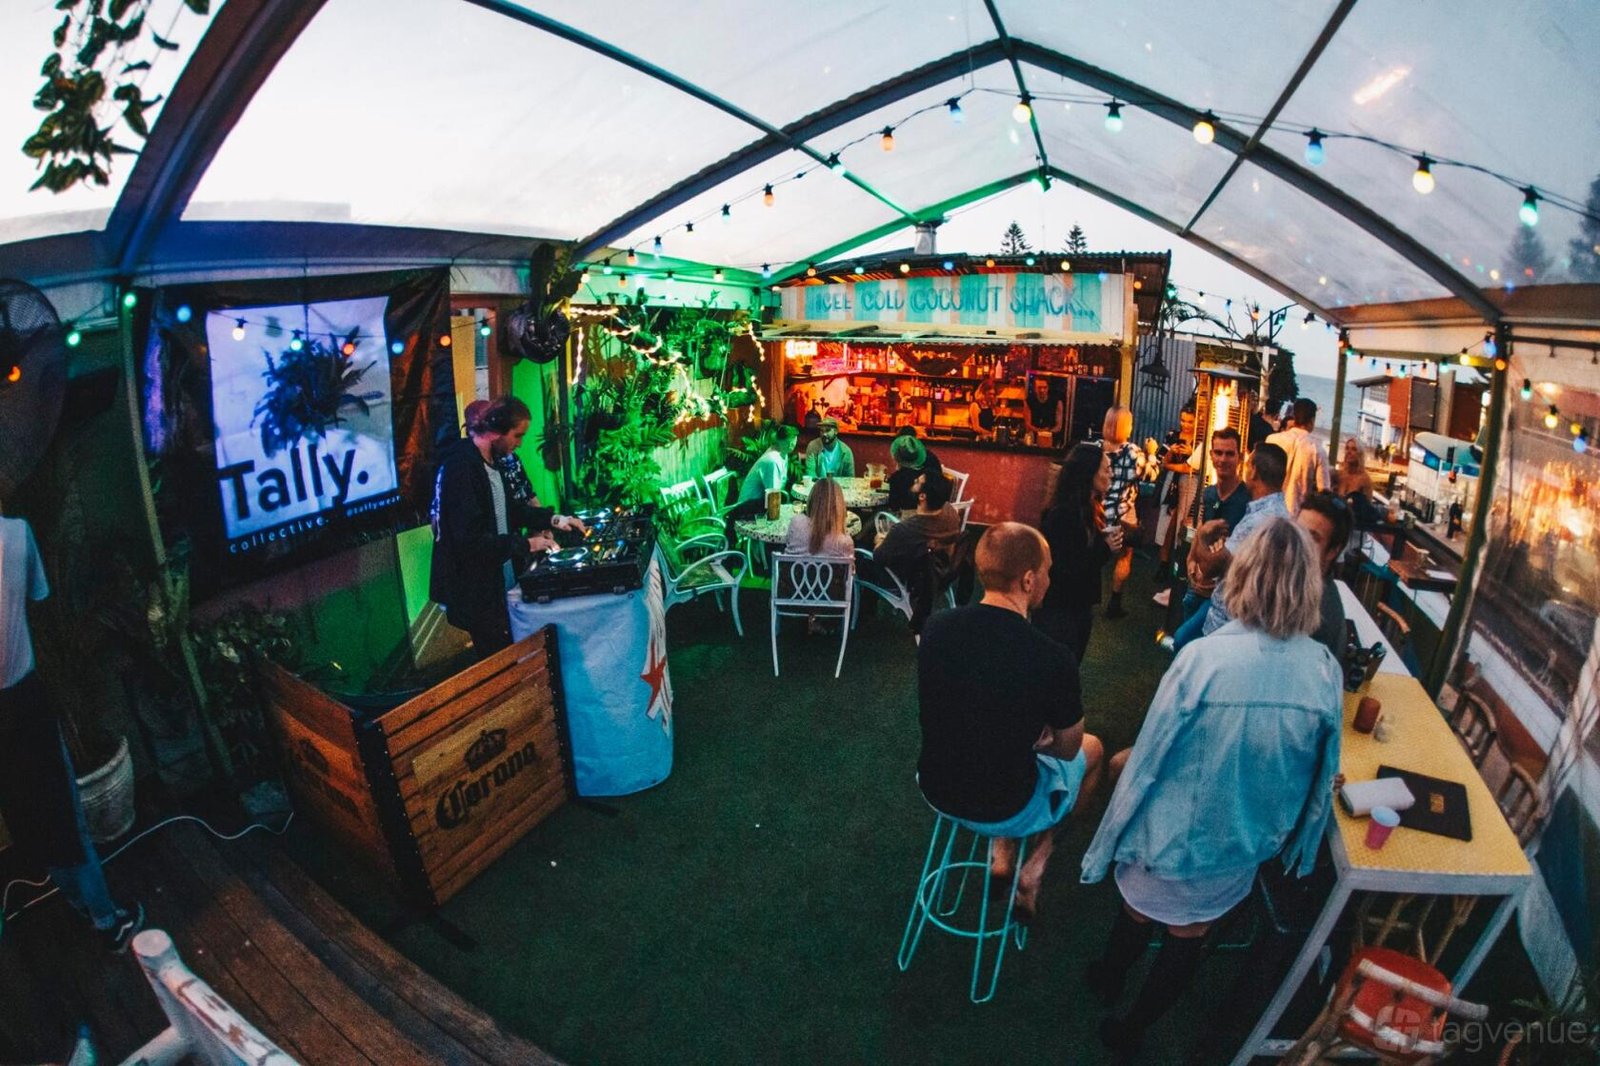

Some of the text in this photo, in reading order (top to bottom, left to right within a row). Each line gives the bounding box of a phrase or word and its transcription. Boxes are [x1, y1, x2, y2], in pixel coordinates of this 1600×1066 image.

[860, 288, 905, 312] COLD
[909, 286, 1003, 314] COCONUT
[216, 444, 370, 522] Tally.
[436, 741, 538, 830] Corona
